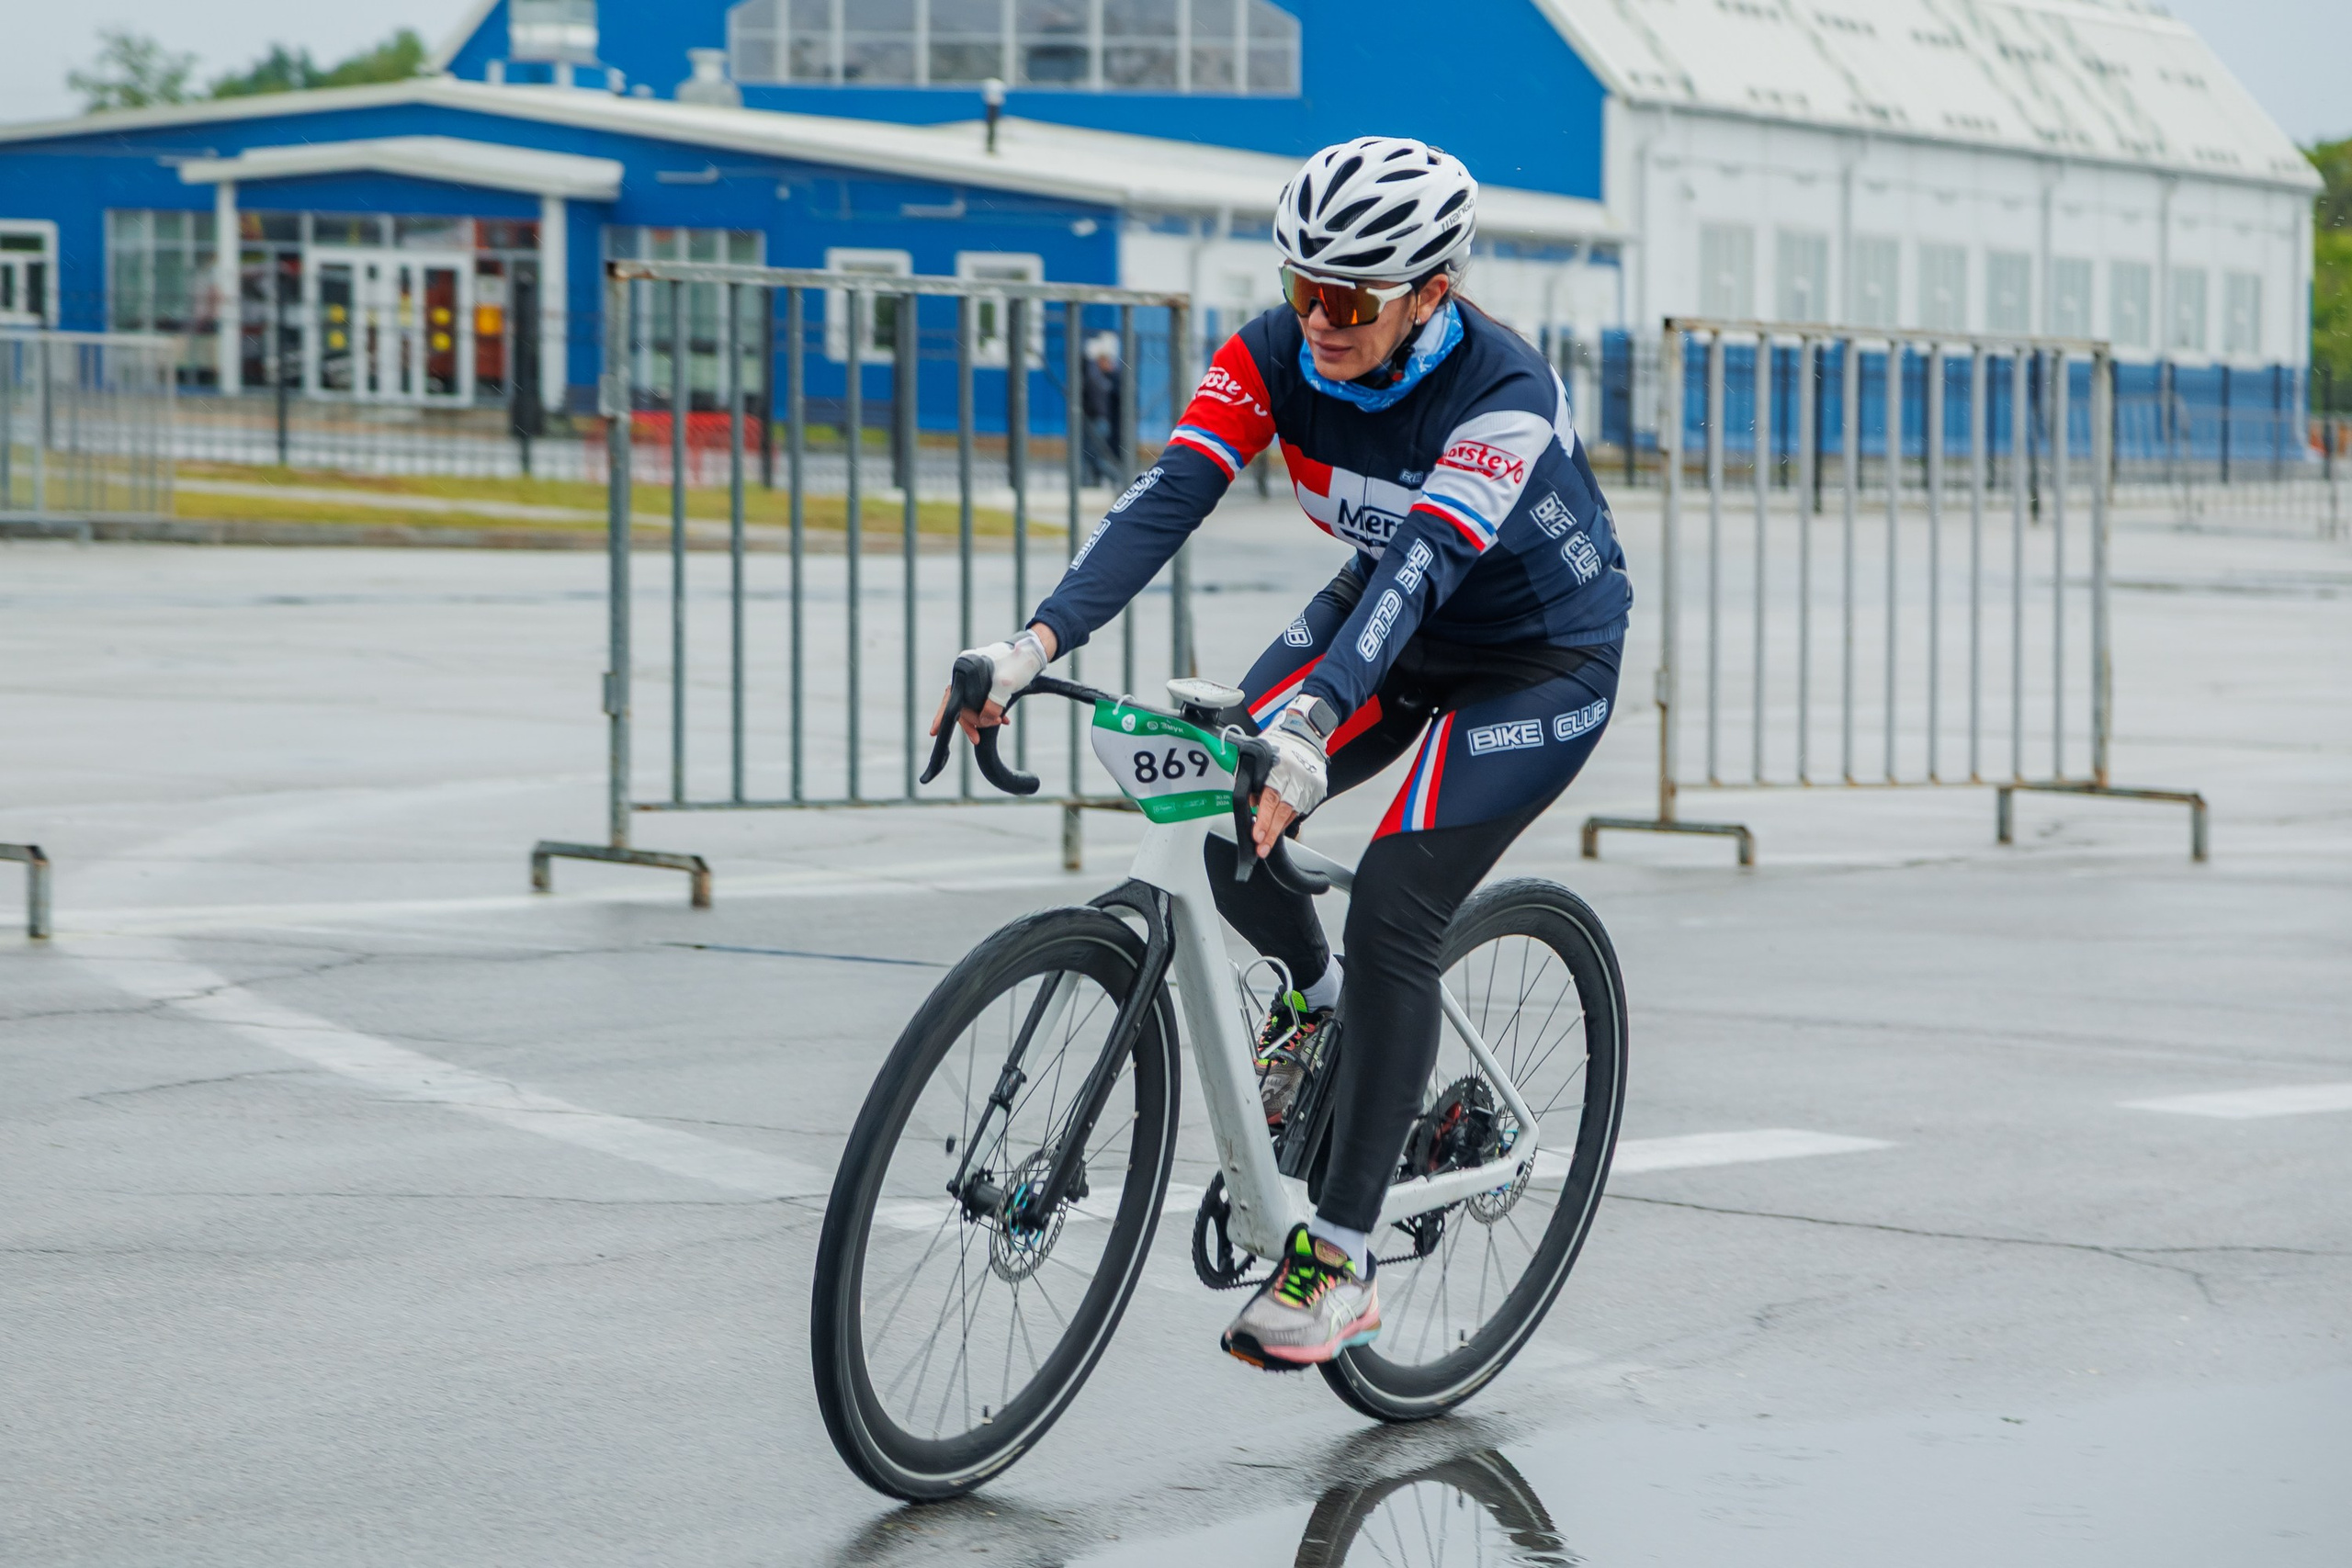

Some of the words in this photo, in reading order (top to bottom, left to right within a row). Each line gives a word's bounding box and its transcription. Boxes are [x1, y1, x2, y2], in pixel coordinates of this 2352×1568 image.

[1358, 591, 1400, 660] CLUB
[1470, 720, 1543, 754] BIKE
[1555, 699, 1607, 739] CLUB
[1134, 748, 1209, 784] 869
